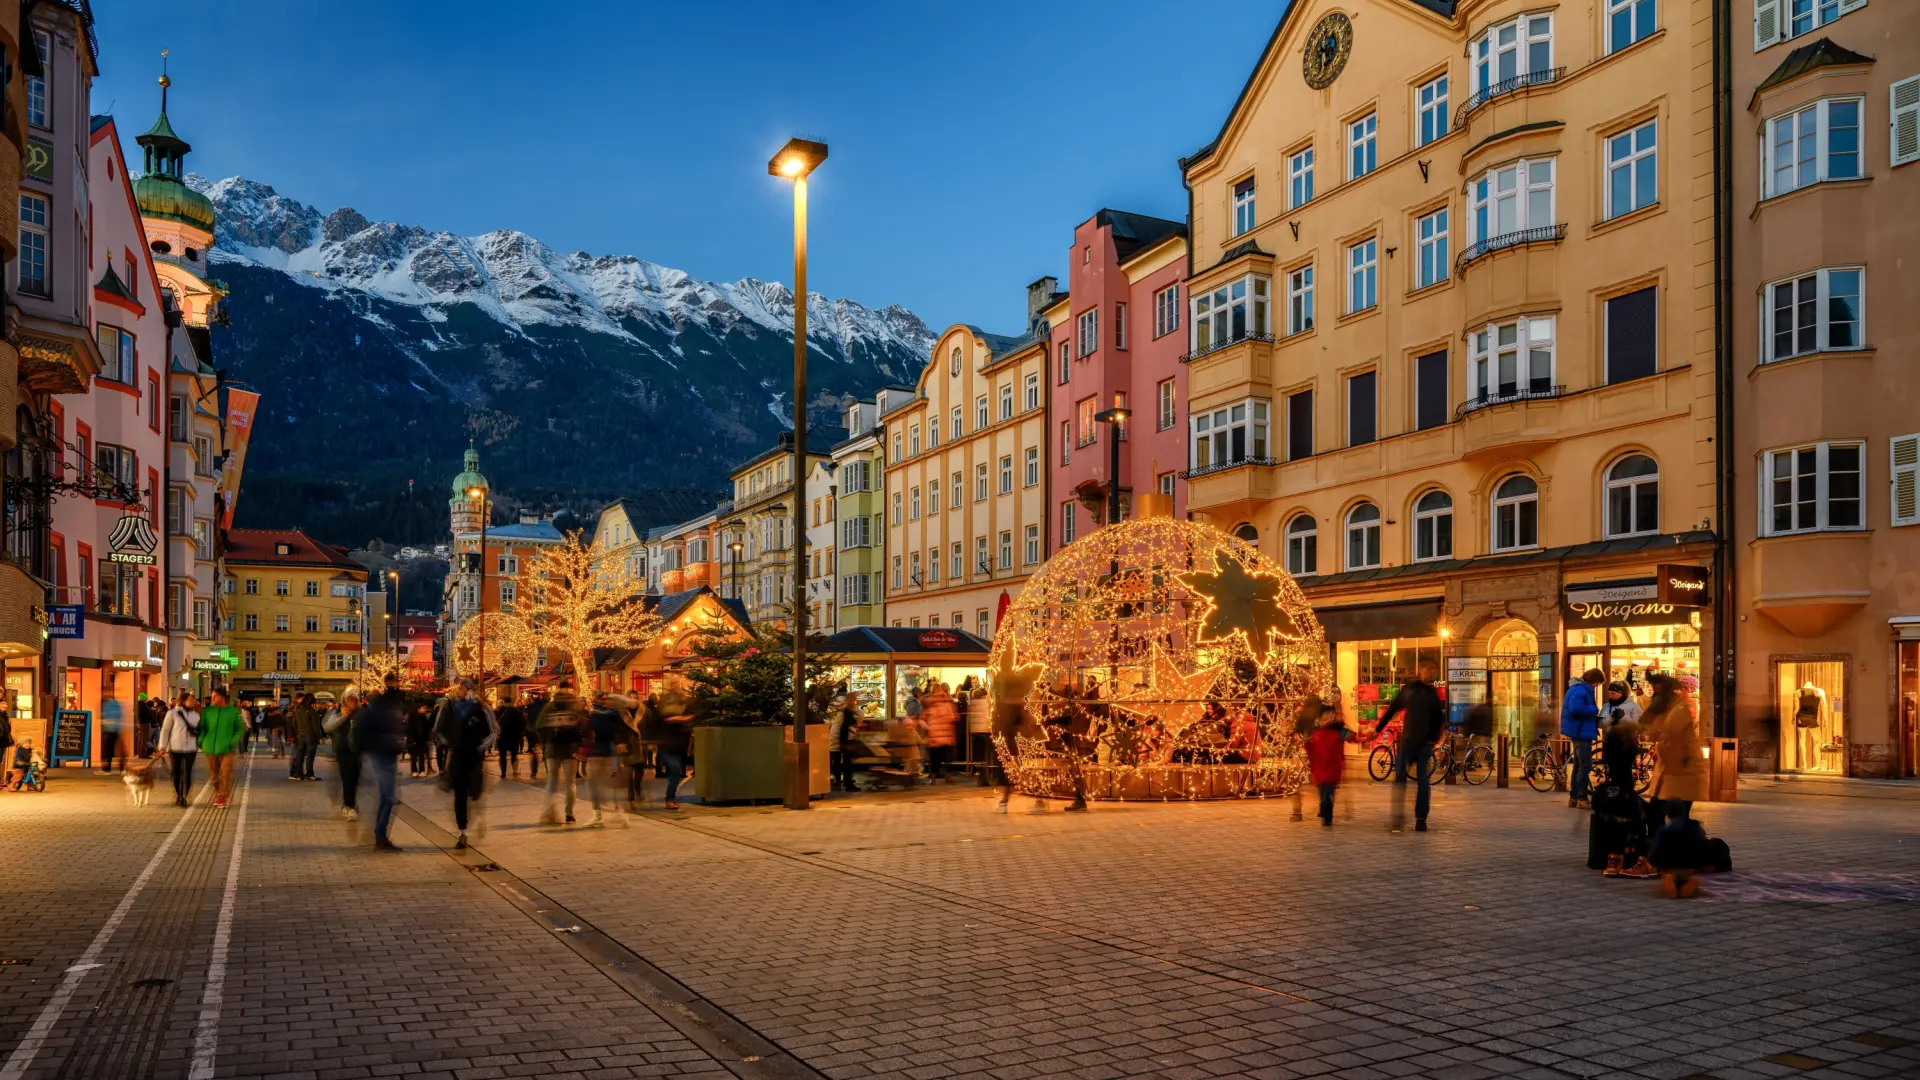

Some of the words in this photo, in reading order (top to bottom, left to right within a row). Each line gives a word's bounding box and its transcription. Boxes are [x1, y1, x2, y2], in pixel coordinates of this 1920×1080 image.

[111, 553, 153, 564] STAGE12
[1669, 578, 1705, 591] Weigand
[1597, 587, 1650, 599] Weigand
[113, 660, 143, 668] NORZ
